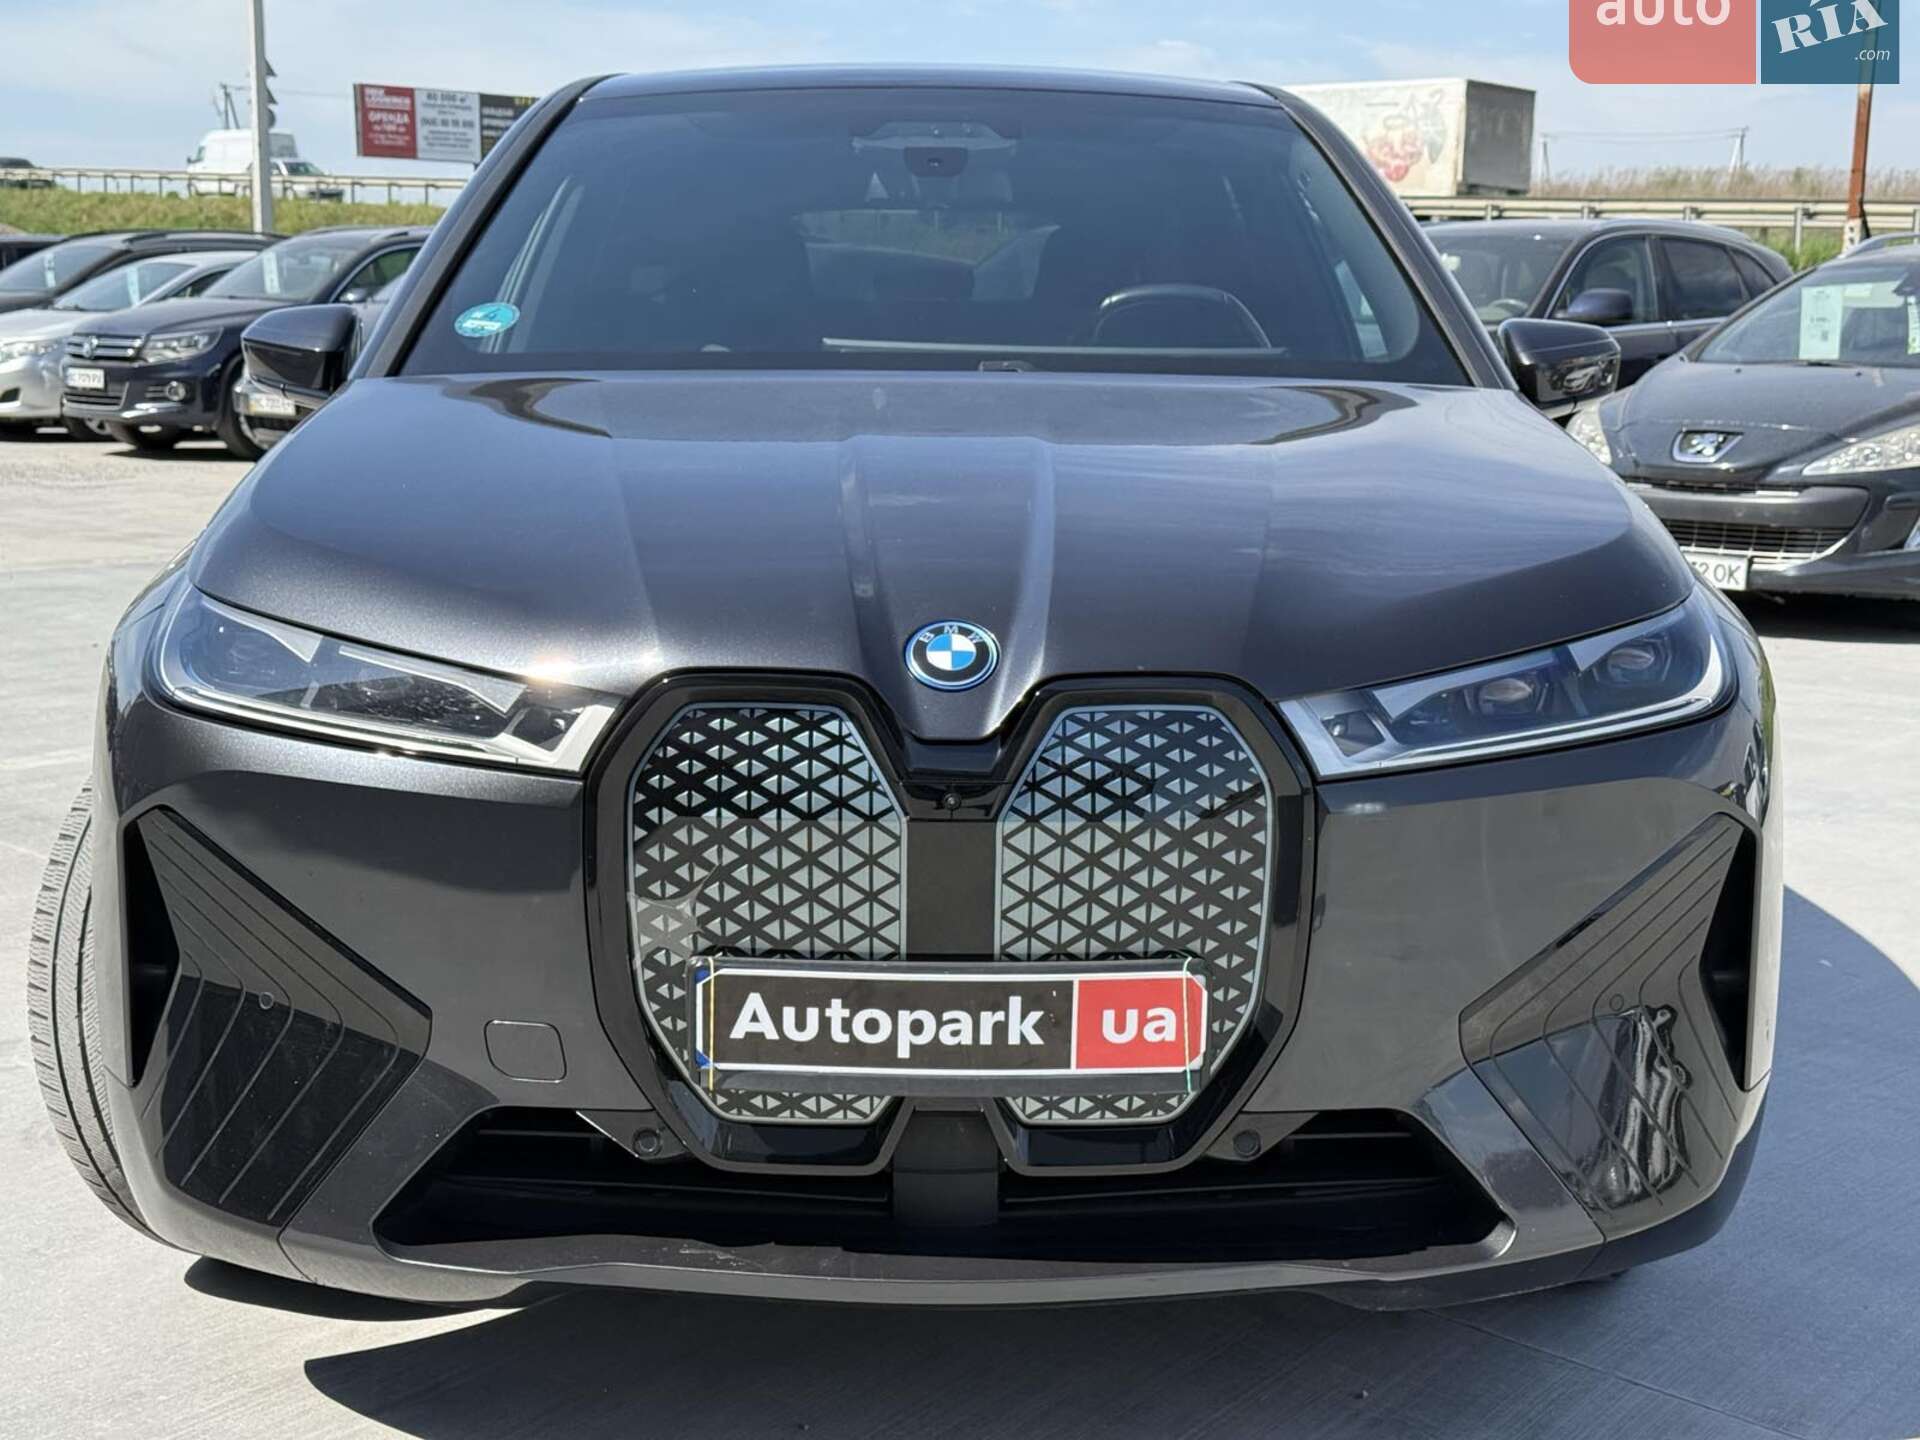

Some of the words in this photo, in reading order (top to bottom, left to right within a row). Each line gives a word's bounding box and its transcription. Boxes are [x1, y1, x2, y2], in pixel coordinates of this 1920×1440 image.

[919, 624, 984, 643] BMW
[730, 992, 1045, 1058] Autopark
[1102, 1004, 1177, 1043] ua
